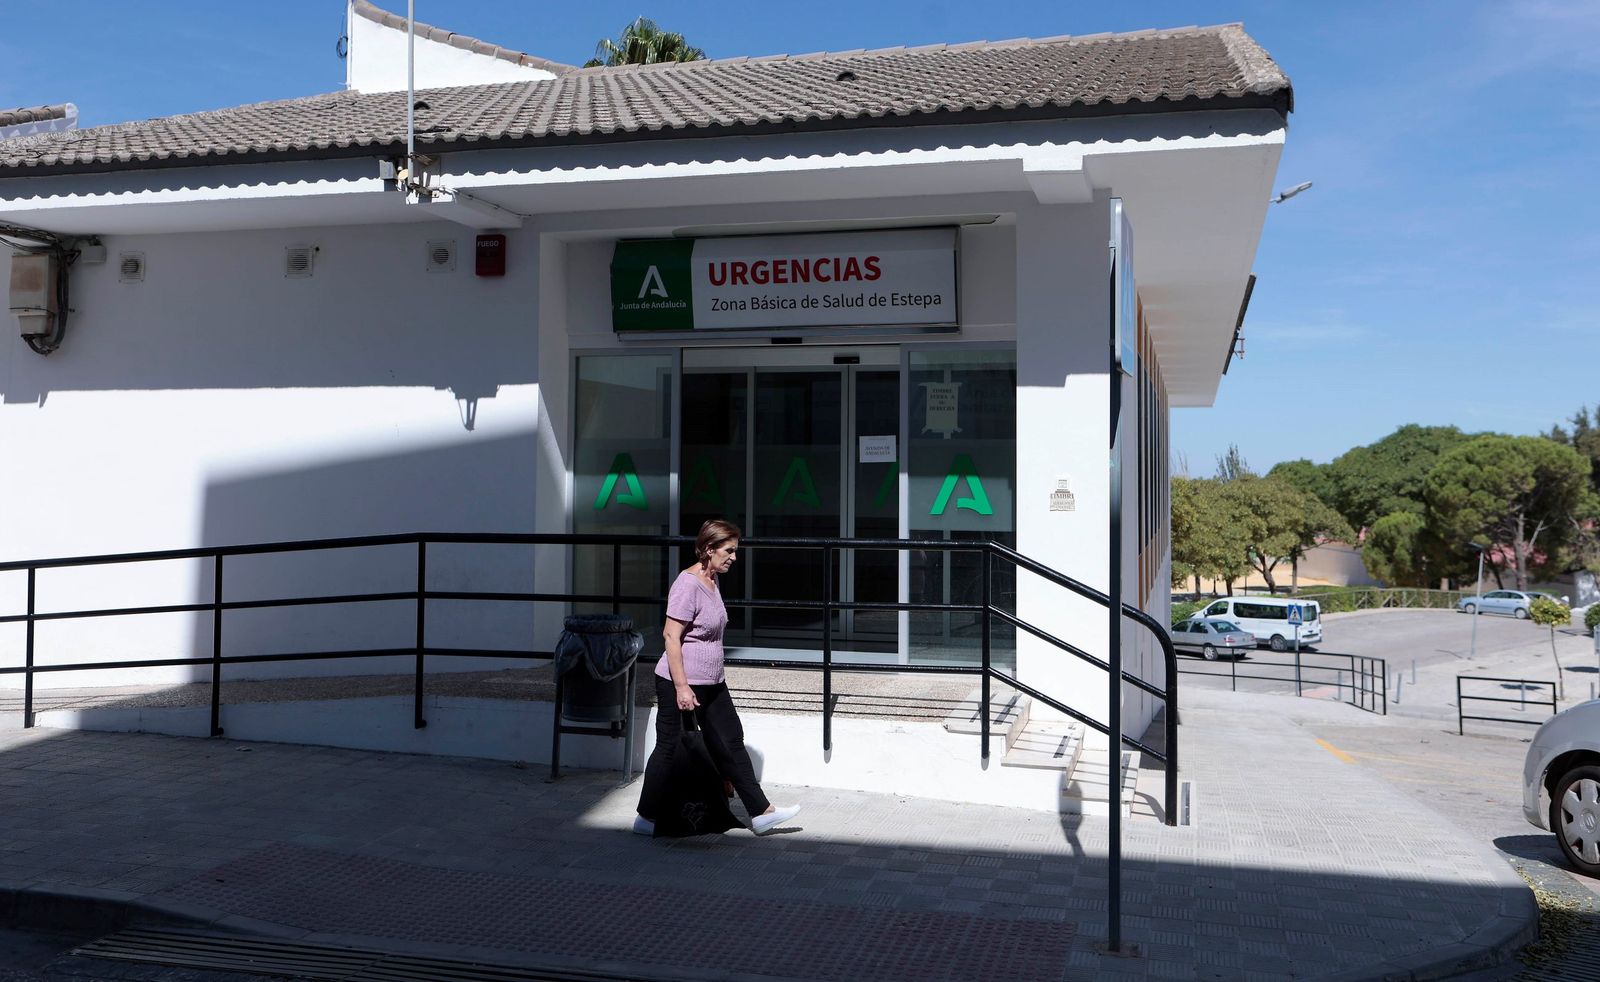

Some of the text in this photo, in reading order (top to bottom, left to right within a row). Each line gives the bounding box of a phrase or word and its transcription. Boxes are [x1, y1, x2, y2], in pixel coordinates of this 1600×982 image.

[477, 240, 499, 248] FUEGO
[708, 255, 882, 287] URGENCIAS
[620, 302, 640, 310] Junta
[641, 301, 650, 309] de
[711, 292, 942, 312] Zona Básica de Salud de Estepa
